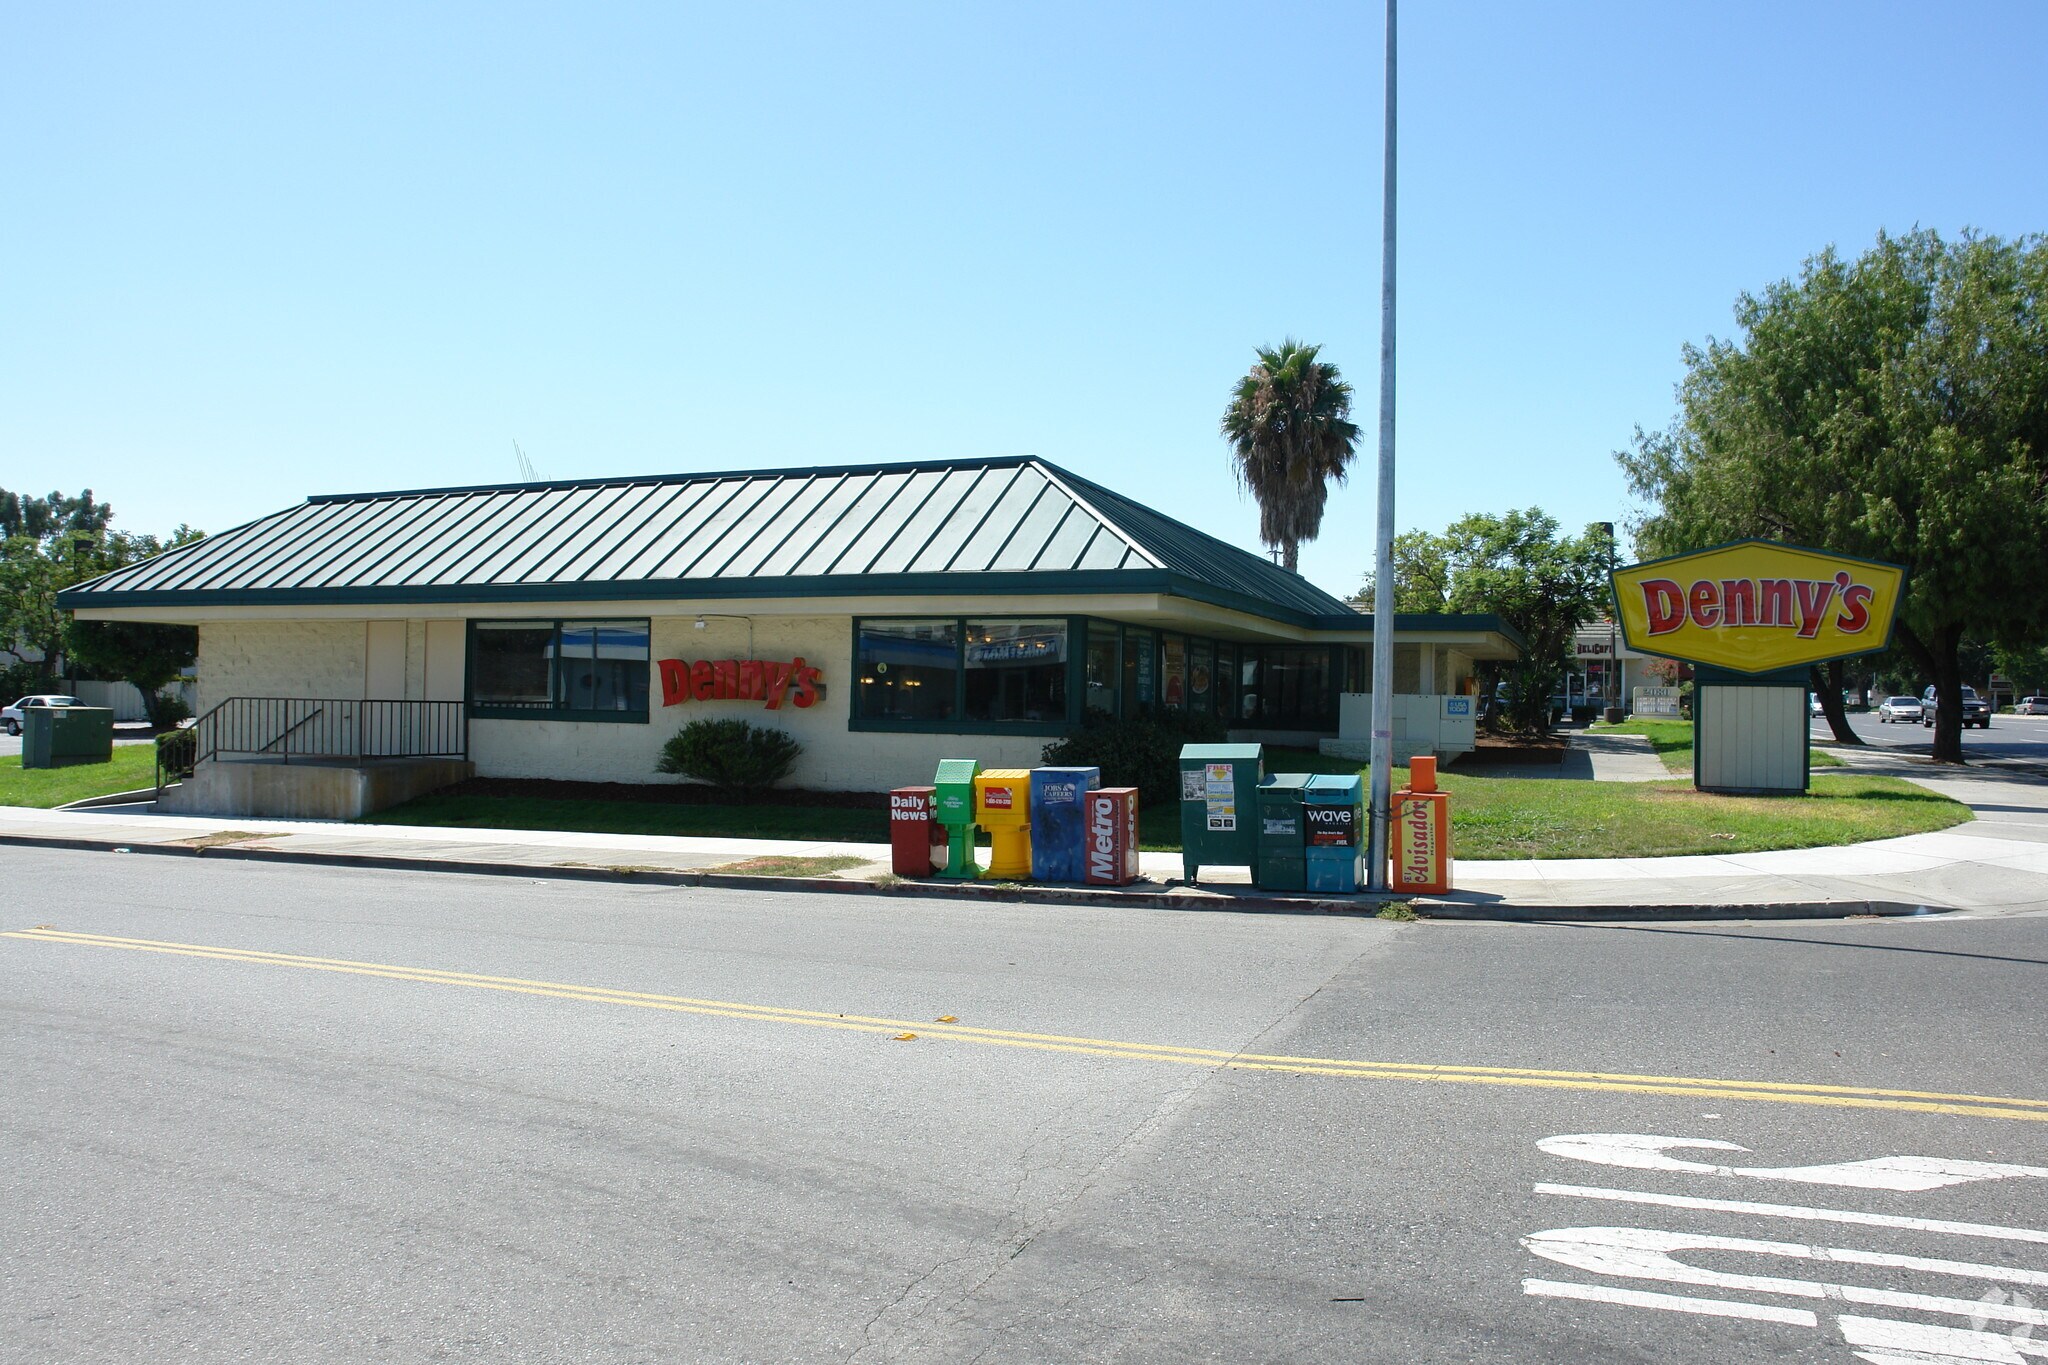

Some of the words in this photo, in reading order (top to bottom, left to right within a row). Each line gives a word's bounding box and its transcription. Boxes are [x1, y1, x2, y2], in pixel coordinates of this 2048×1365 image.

[1639, 569, 1877, 640] Denny's
[657, 656, 822, 710] Denny's
[891, 796, 925, 810] Daily
[891, 809, 928, 821] News
[1127, 794, 1135, 873] Metro
[1307, 810, 1351, 822] wave
[1091, 798, 1114, 880] Metro
[1407, 801, 1428, 883] Avisador
